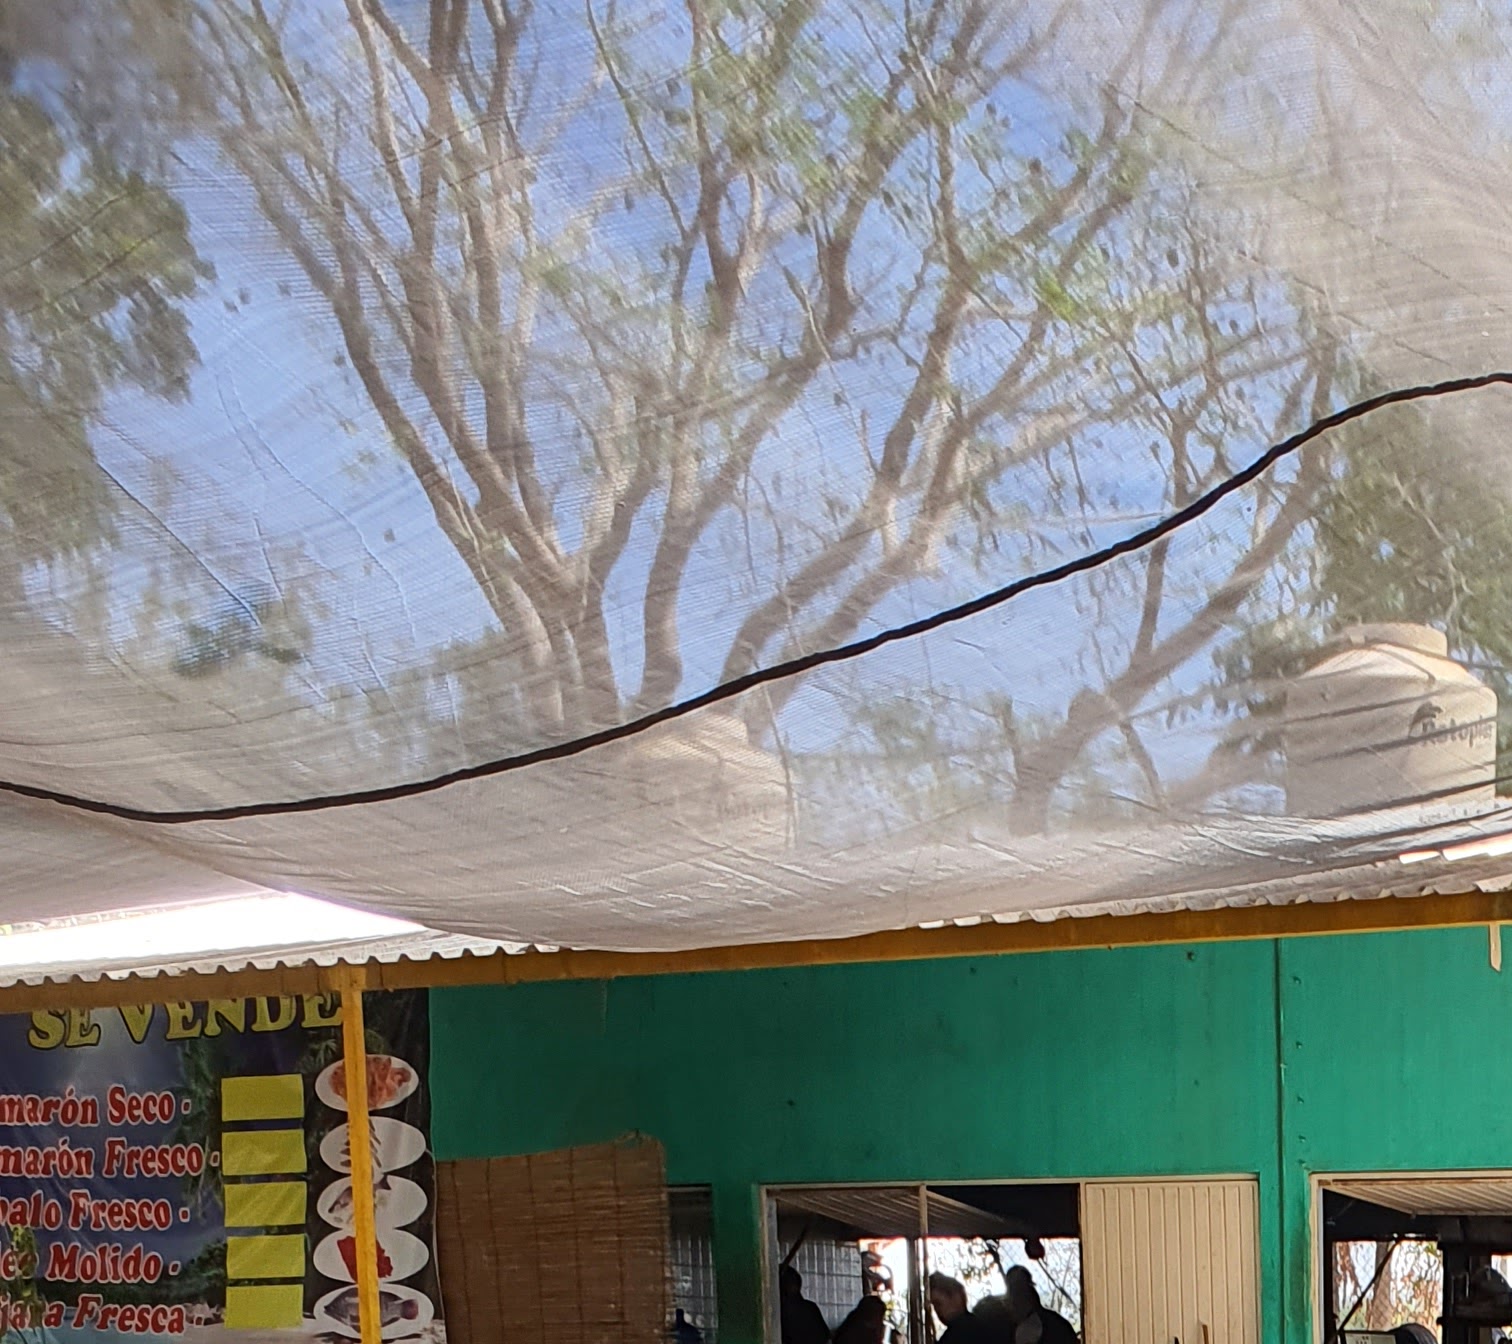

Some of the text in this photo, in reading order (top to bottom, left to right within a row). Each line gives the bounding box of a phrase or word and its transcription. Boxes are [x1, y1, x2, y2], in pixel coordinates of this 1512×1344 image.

[28, 992, 344, 1050] SE VENDE
[107, 1084, 175, 1126] Seco
[102, 1137, 204, 1178] Fresco
[68, 1189, 173, 1231] Fresco
[45, 1241, 163, 1283] Molido
[71, 1293, 186, 1335] Fresca
